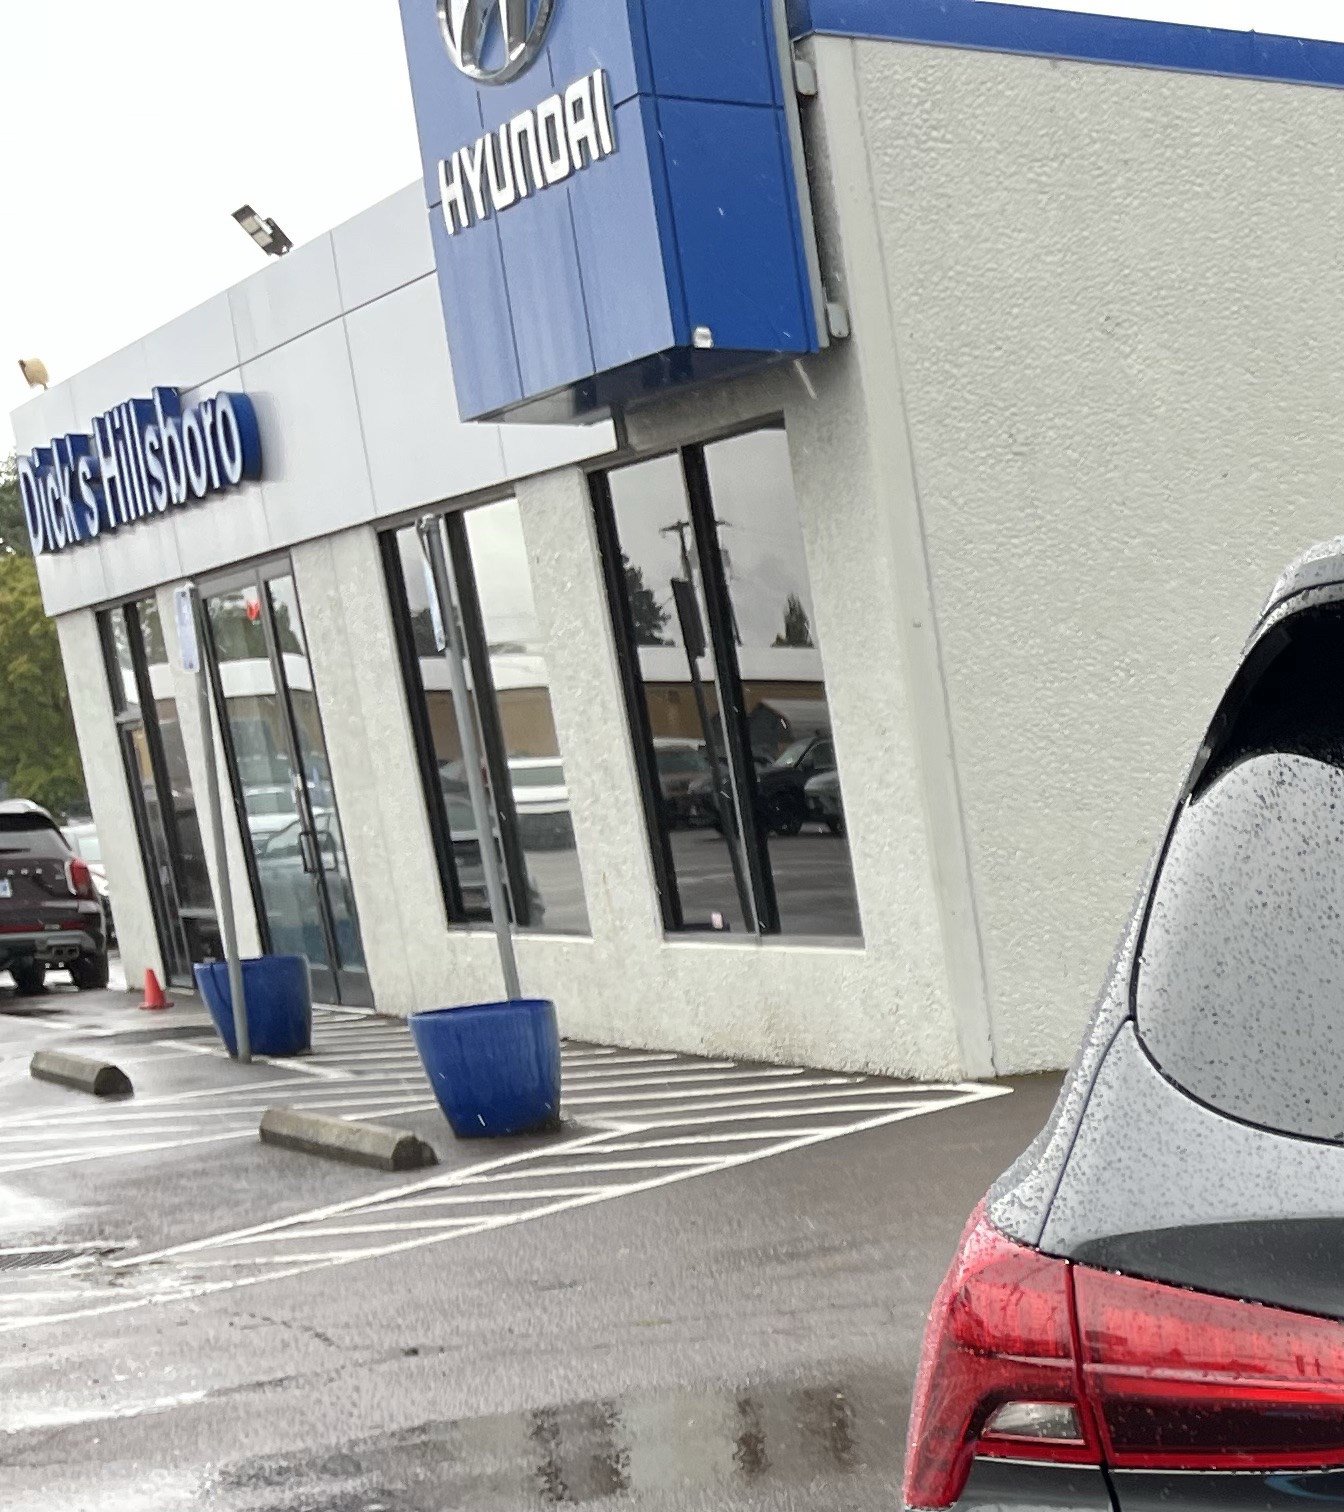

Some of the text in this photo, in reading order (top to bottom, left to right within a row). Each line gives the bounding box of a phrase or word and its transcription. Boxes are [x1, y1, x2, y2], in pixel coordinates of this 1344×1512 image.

[438, 68, 615, 235] HYUNDAI
[17, 387, 245, 555] Dick's Hillsboro
